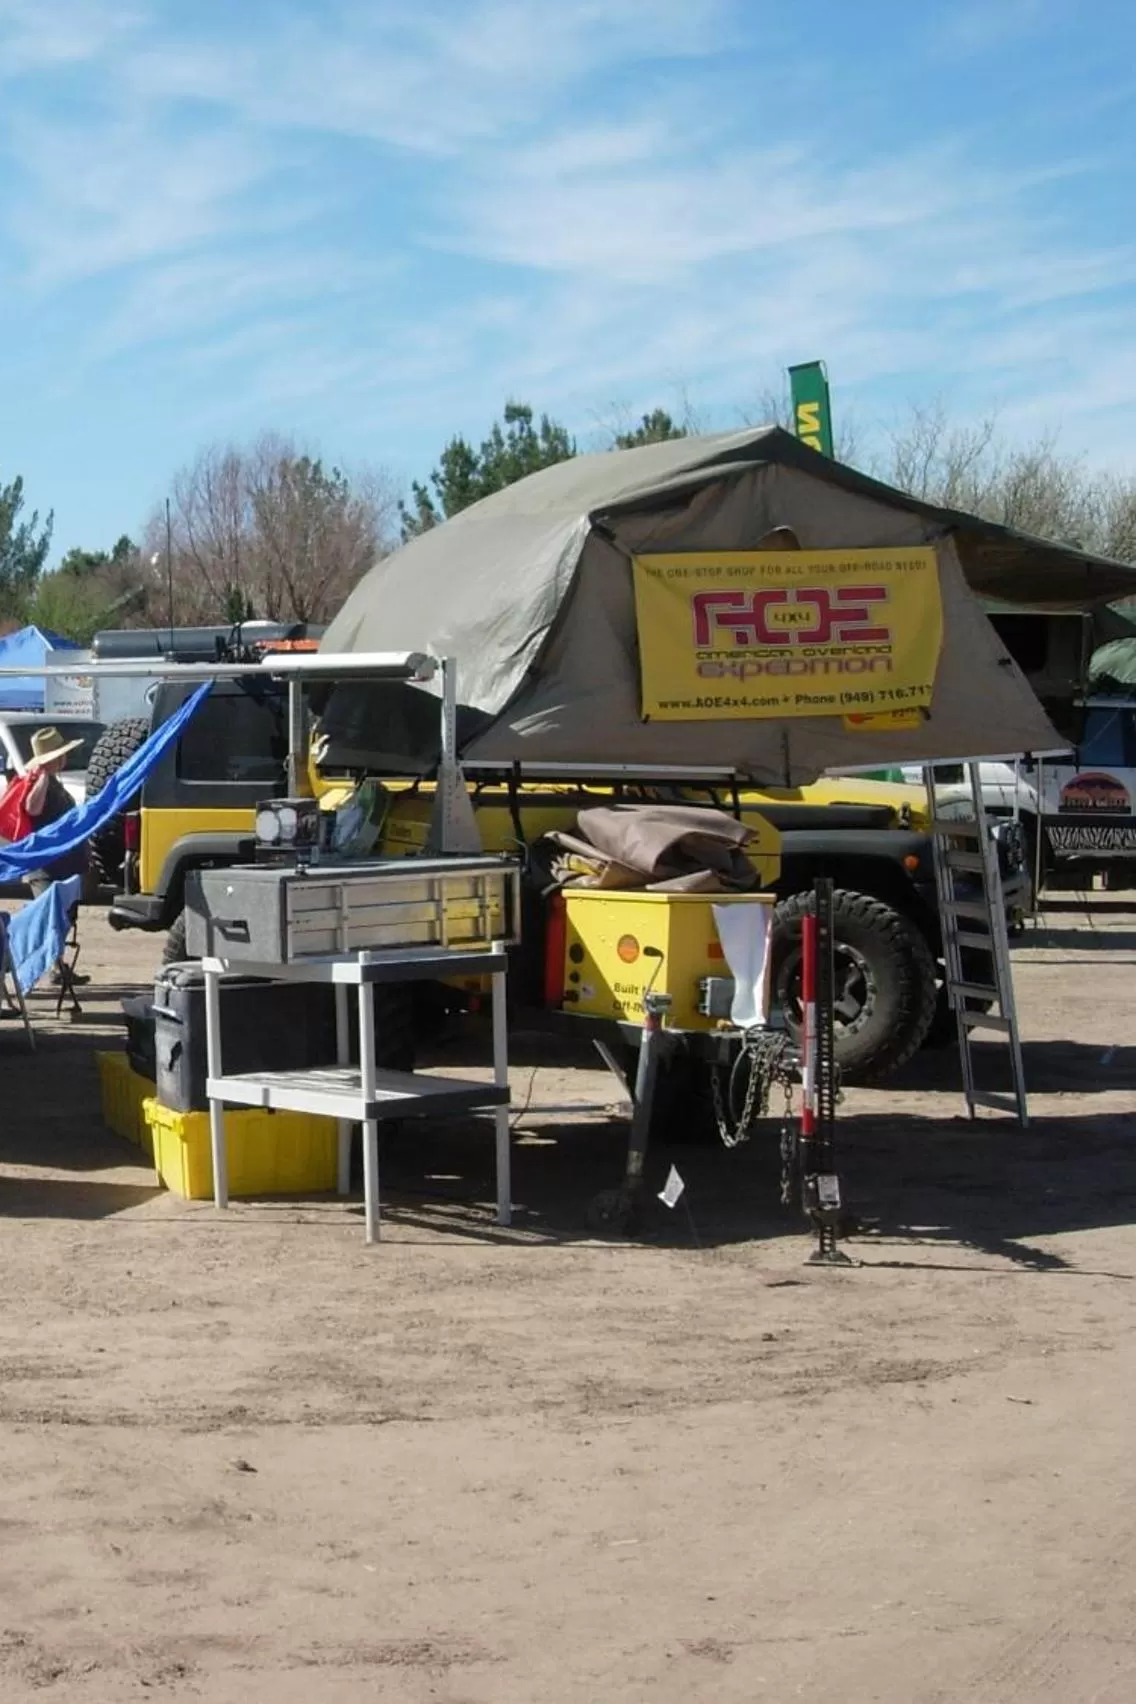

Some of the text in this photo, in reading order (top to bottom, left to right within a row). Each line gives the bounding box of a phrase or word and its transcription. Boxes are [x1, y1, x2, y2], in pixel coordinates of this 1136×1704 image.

[726, 566, 756, 577] SHOP
[760, 565, 781, 575] FOR
[785, 565, 803, 575] ALL
[807, 564, 836, 574] YOUR
[658, 696, 779, 709] www.AOE4x4.com
[794, 692, 836, 704] Phone
[840, 690, 874, 704] (949)
[614, 983, 639, 995] Built
